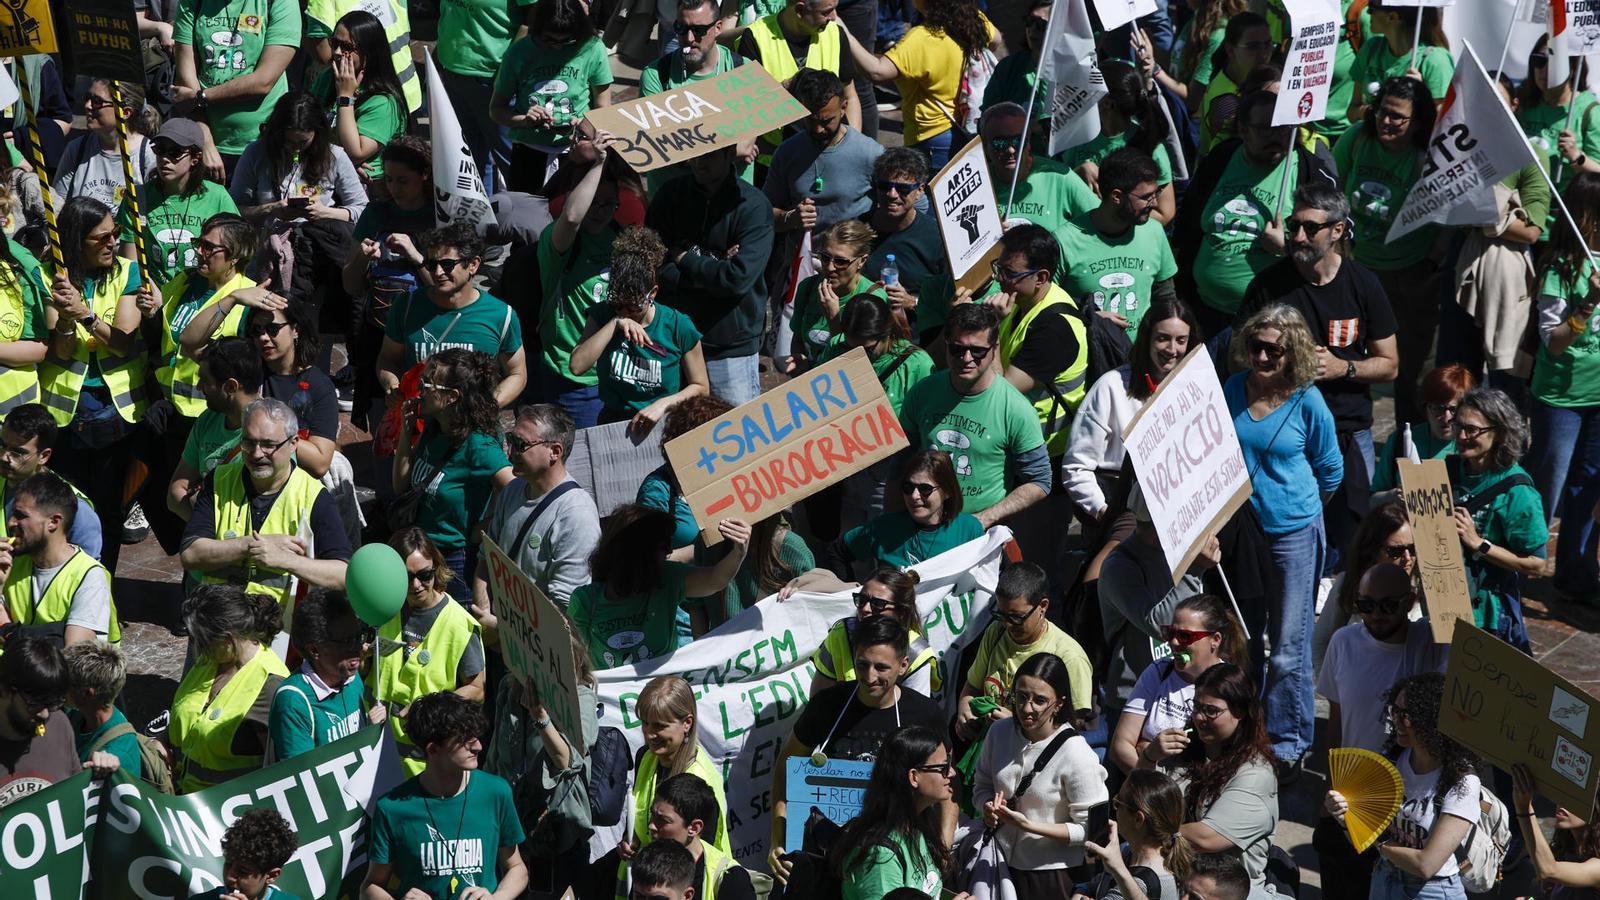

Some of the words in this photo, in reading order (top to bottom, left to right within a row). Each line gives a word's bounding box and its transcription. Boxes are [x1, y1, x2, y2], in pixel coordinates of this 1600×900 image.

[75, 13, 91, 25] NO
[96, 16, 108, 28] HI
[112, 19, 129, 31] HA
[1300, 24, 1325, 39] DEMPEUS
[1325, 21, 1335, 34] PER
[79, 30, 131, 50] FUTUR
[1295, 40, 1308, 51] UNA
[1292, 66, 1301, 77] DE
[1303, 61, 1328, 77] QUALITAT
[1292, 79, 1301, 90] EN
[617, 90, 722, 130] VAGA
[725, 84, 780, 115] PAS
[714, 97, 805, 140] DOCENT
[614, 129, 671, 167] 31
[655, 122, 717, 152] MARÇ
[84, 179, 98, 190] THE
[944, 170, 982, 217] MATTER
[947, 162, 972, 196] ARTS
[1089, 256, 1145, 274] ESTIMEM
[1162, 402, 1177, 430] NO
[1189, 380, 1205, 407] HA
[1146, 390, 1224, 510] VOCACIÓ
[490, 551, 539, 630] PROU
[549, 648, 569, 692] AL
[1461, 636, 1539, 709] Sense
[1450, 676, 1484, 718] NO
[421, 842, 436, 870] LA
[437, 838, 483, 870] LLENGUA
[439, 868, 452, 876] ES
[455, 866, 482, 875] TOCA
